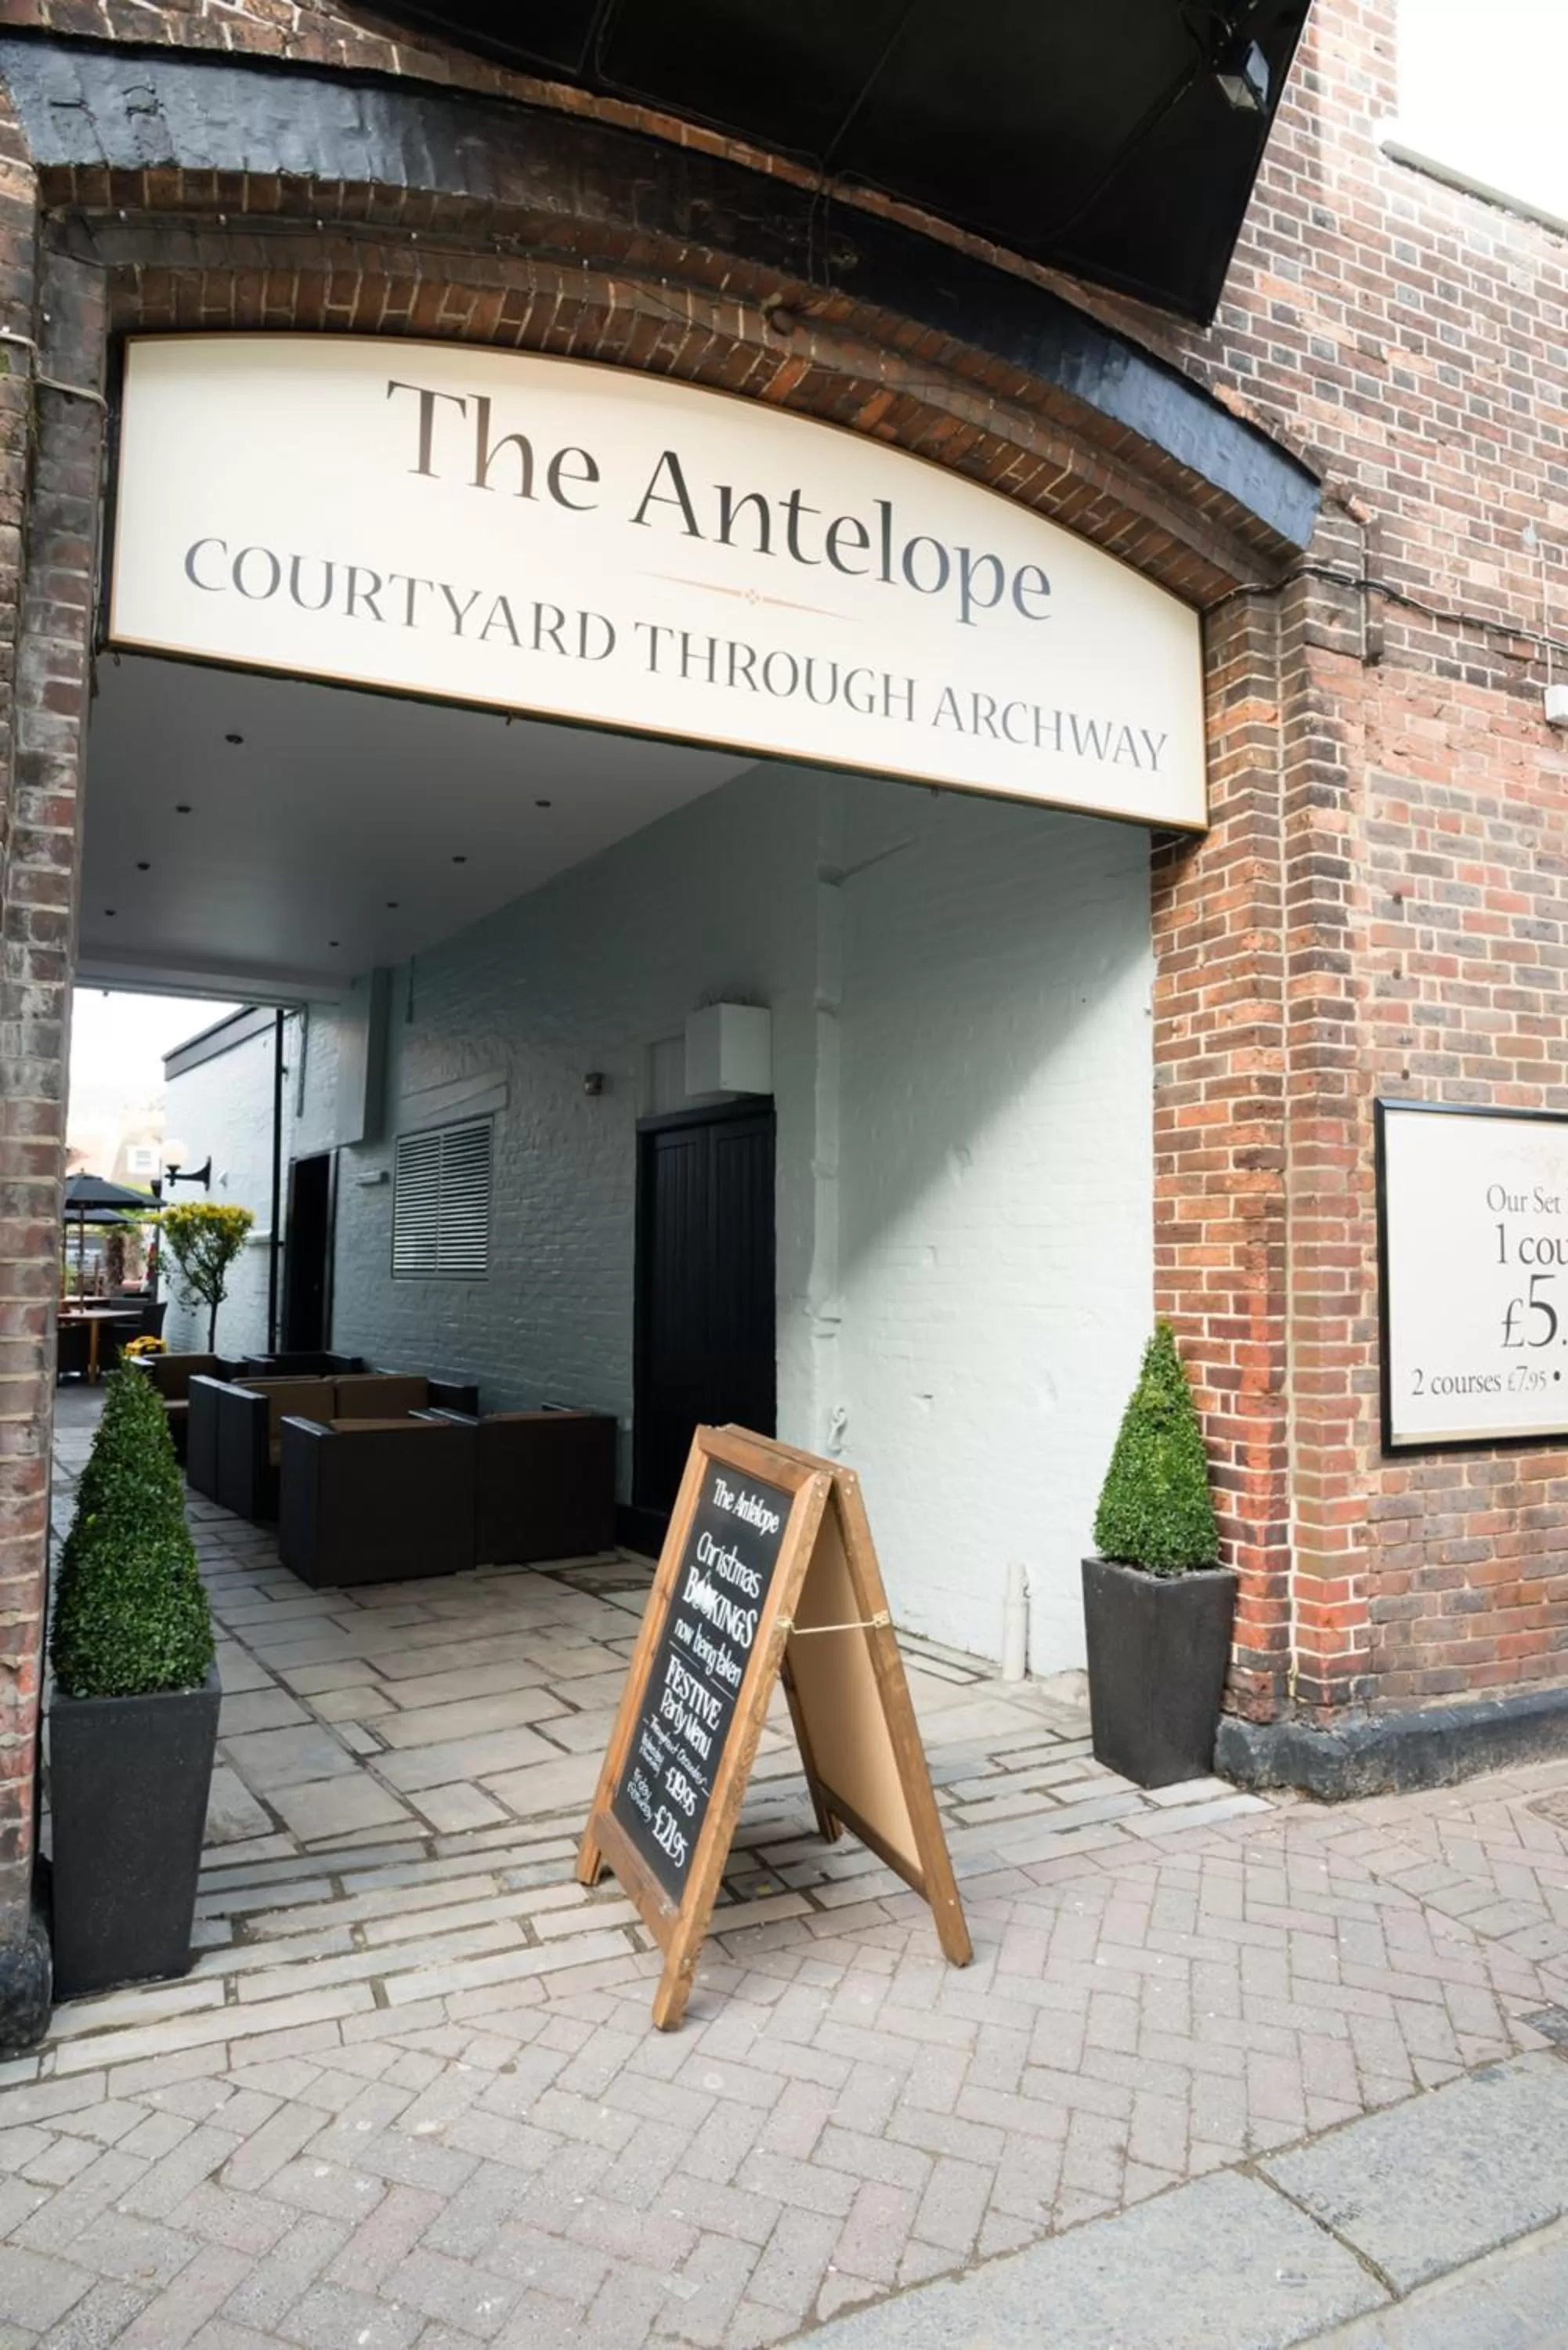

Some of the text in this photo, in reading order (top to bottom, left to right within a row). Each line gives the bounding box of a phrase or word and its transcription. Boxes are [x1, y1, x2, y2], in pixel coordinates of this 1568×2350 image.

[386, 380, 1052, 627] The Antelope
[184, 537, 1169, 772] COURTYARD THROUGH ARCHWAY
[1487, 1184, 1562, 1214] Our Set
[1497, 1223, 1508, 1264] 1
[1411, 1365, 1547, 1396] 2 courses £7.95
[713, 1477, 780, 1536] The Antelope
[696, 1531, 763, 1599] Christmas
[674, 1618, 742, 1688] now being taken
[659, 1687, 713, 1761] Party Menu
[664, 1654, 722, 1730] FESTIVE
